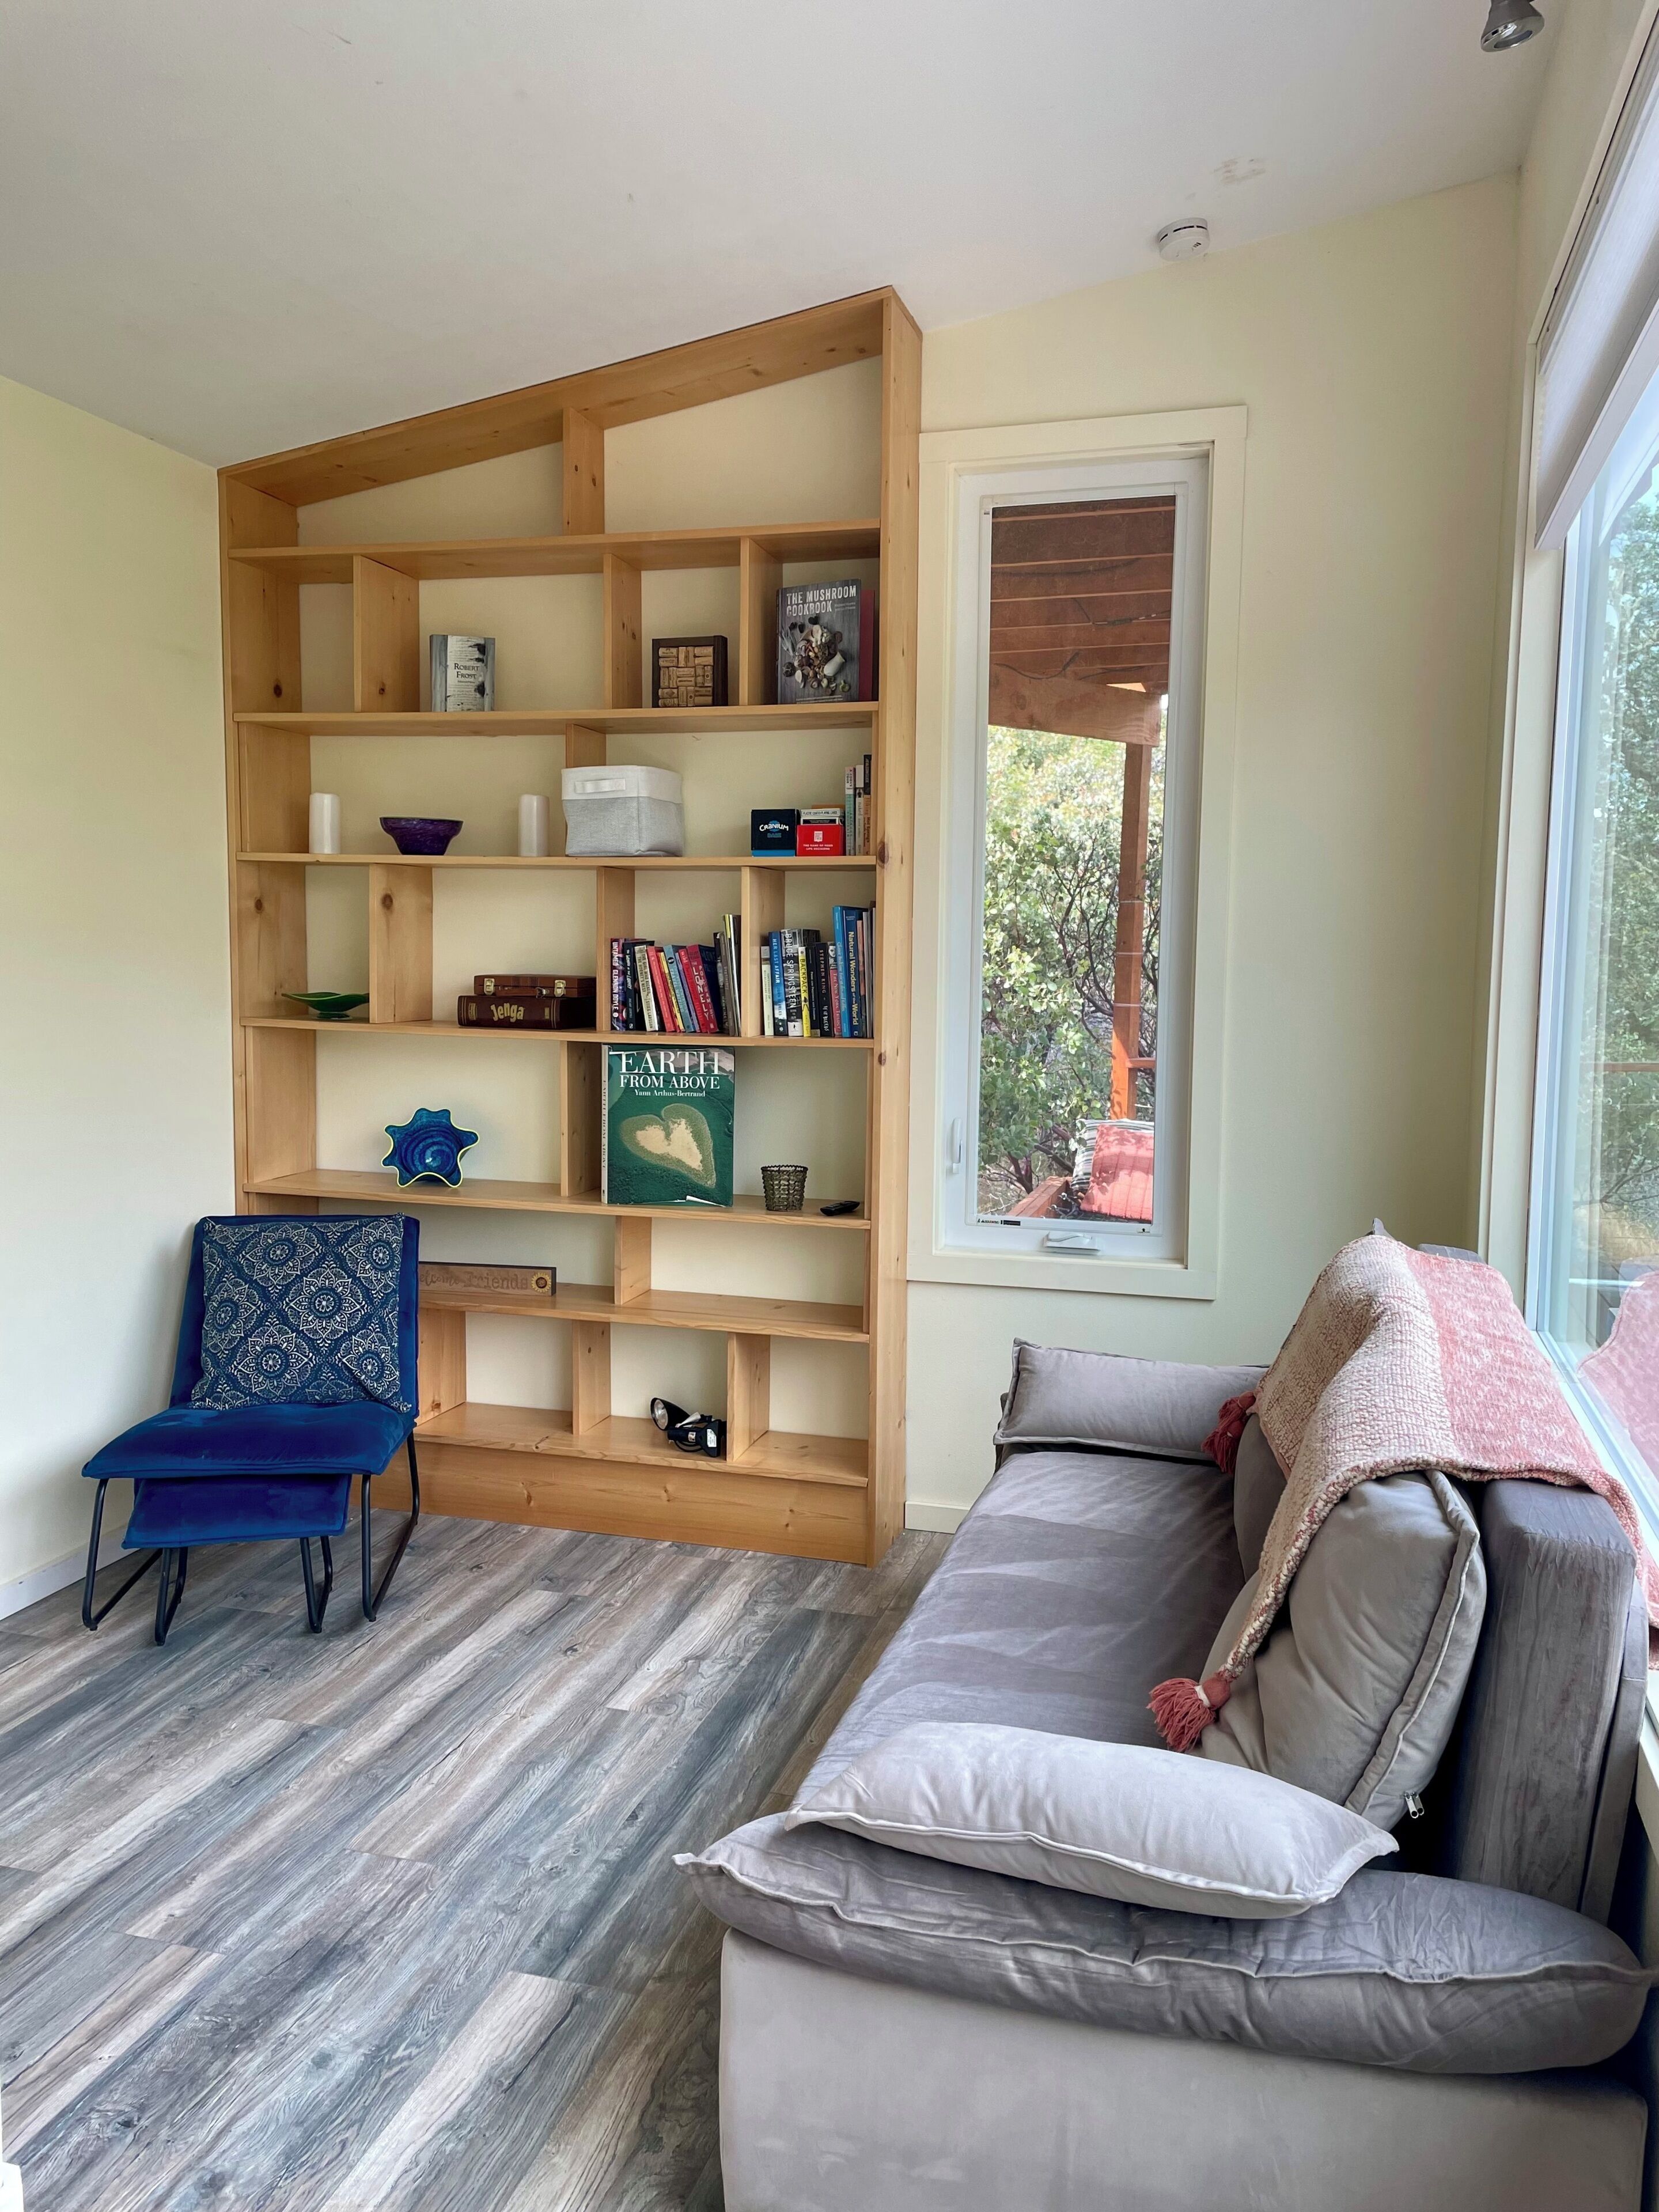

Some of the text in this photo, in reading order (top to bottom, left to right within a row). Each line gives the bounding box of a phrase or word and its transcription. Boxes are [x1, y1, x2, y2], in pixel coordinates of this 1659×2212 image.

[786, 585, 856, 605] THE MUSHROOM
[786, 601, 832, 617] COOKBOOK
[454, 663, 480, 671] ROBERT
[785, 933, 793, 957] BRUCE
[693, 967, 710, 1020] LONELY
[787, 960, 797, 1008] SPRINGSTEEN
[676, 990, 684, 1012] WRITING
[490, 1003, 525, 1022] Jenga
[619, 1051, 720, 1074] EARTH
[619, 1075, 720, 1089] FROM ABOVE
[419, 1270, 528, 1290] elcome Friends
